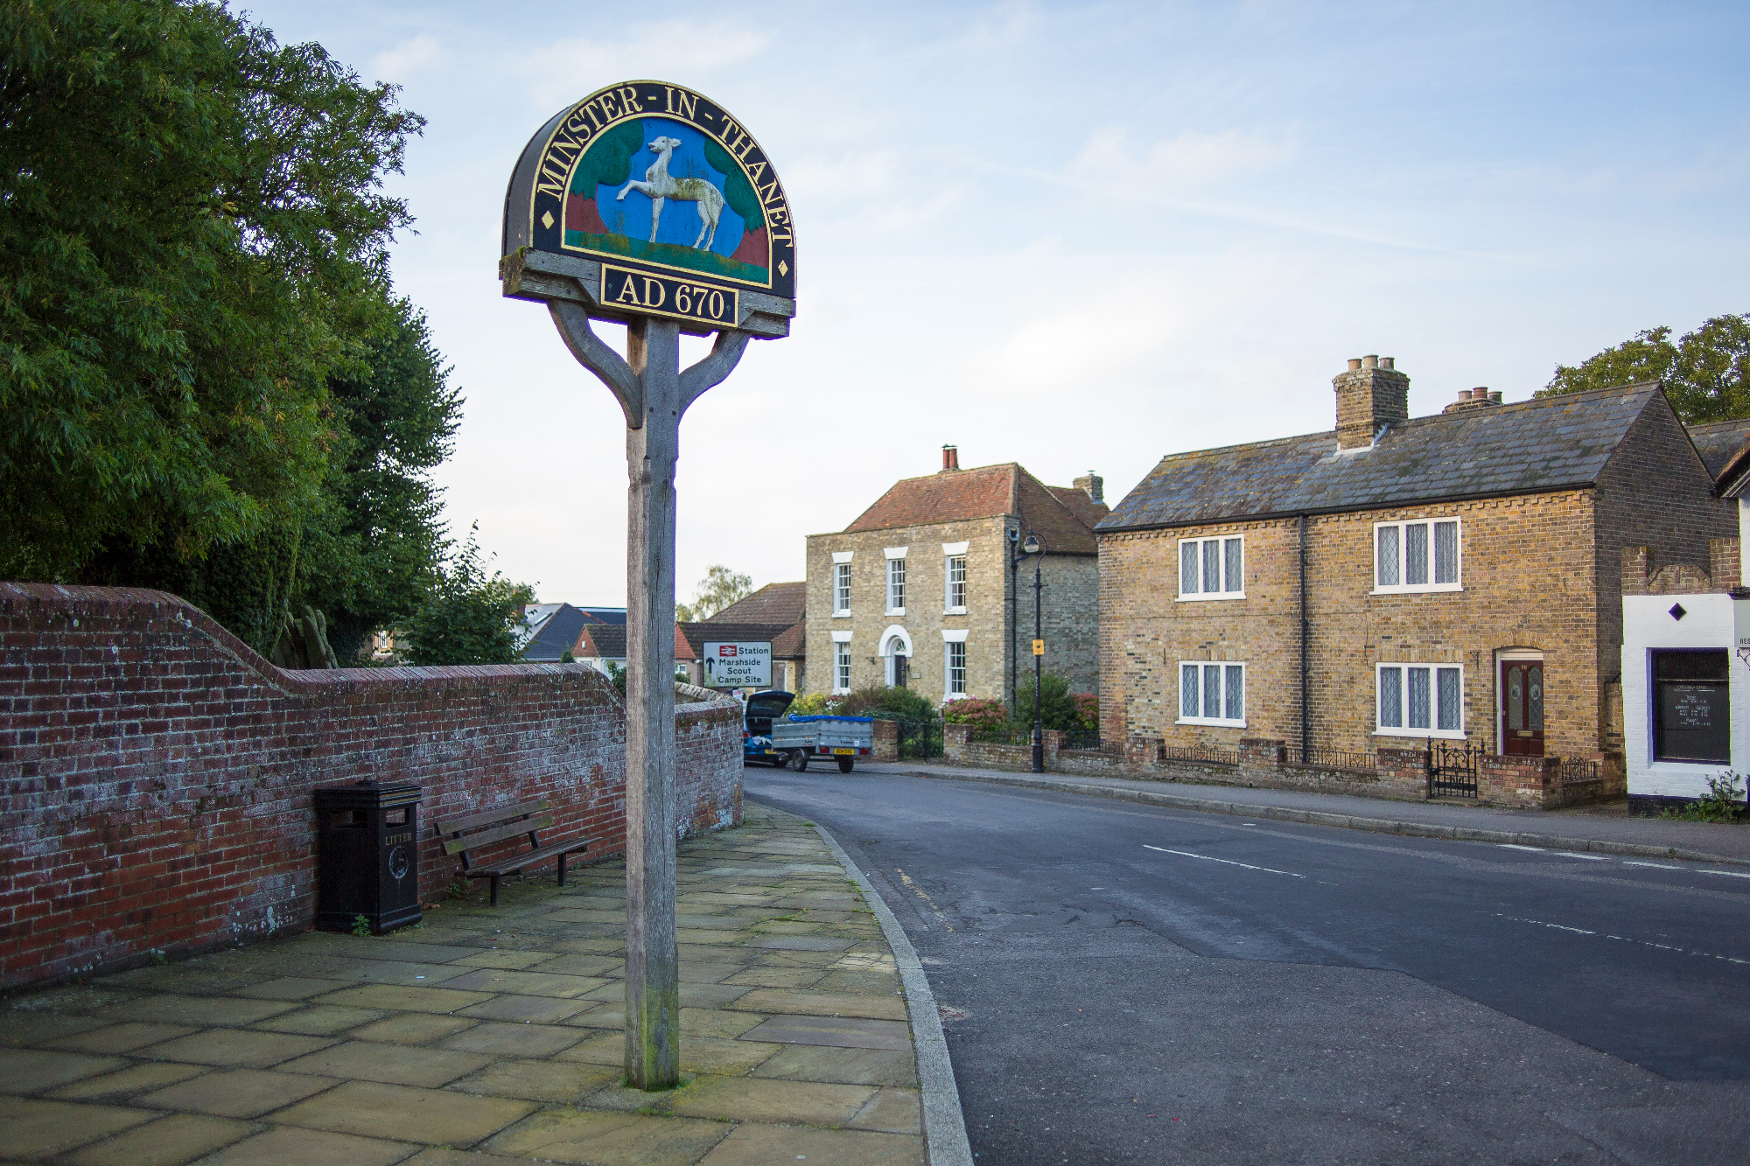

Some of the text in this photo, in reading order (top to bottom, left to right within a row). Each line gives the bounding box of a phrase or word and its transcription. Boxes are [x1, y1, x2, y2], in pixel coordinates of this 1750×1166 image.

[616, 274, 725, 319] AD 670
[738, 647, 769, 655] Station
[719, 658, 761, 666] Marshside
[727, 667, 752, 675] Scout
[718, 675, 762, 684] Camp Site
[385, 832, 412, 846] LITTER
